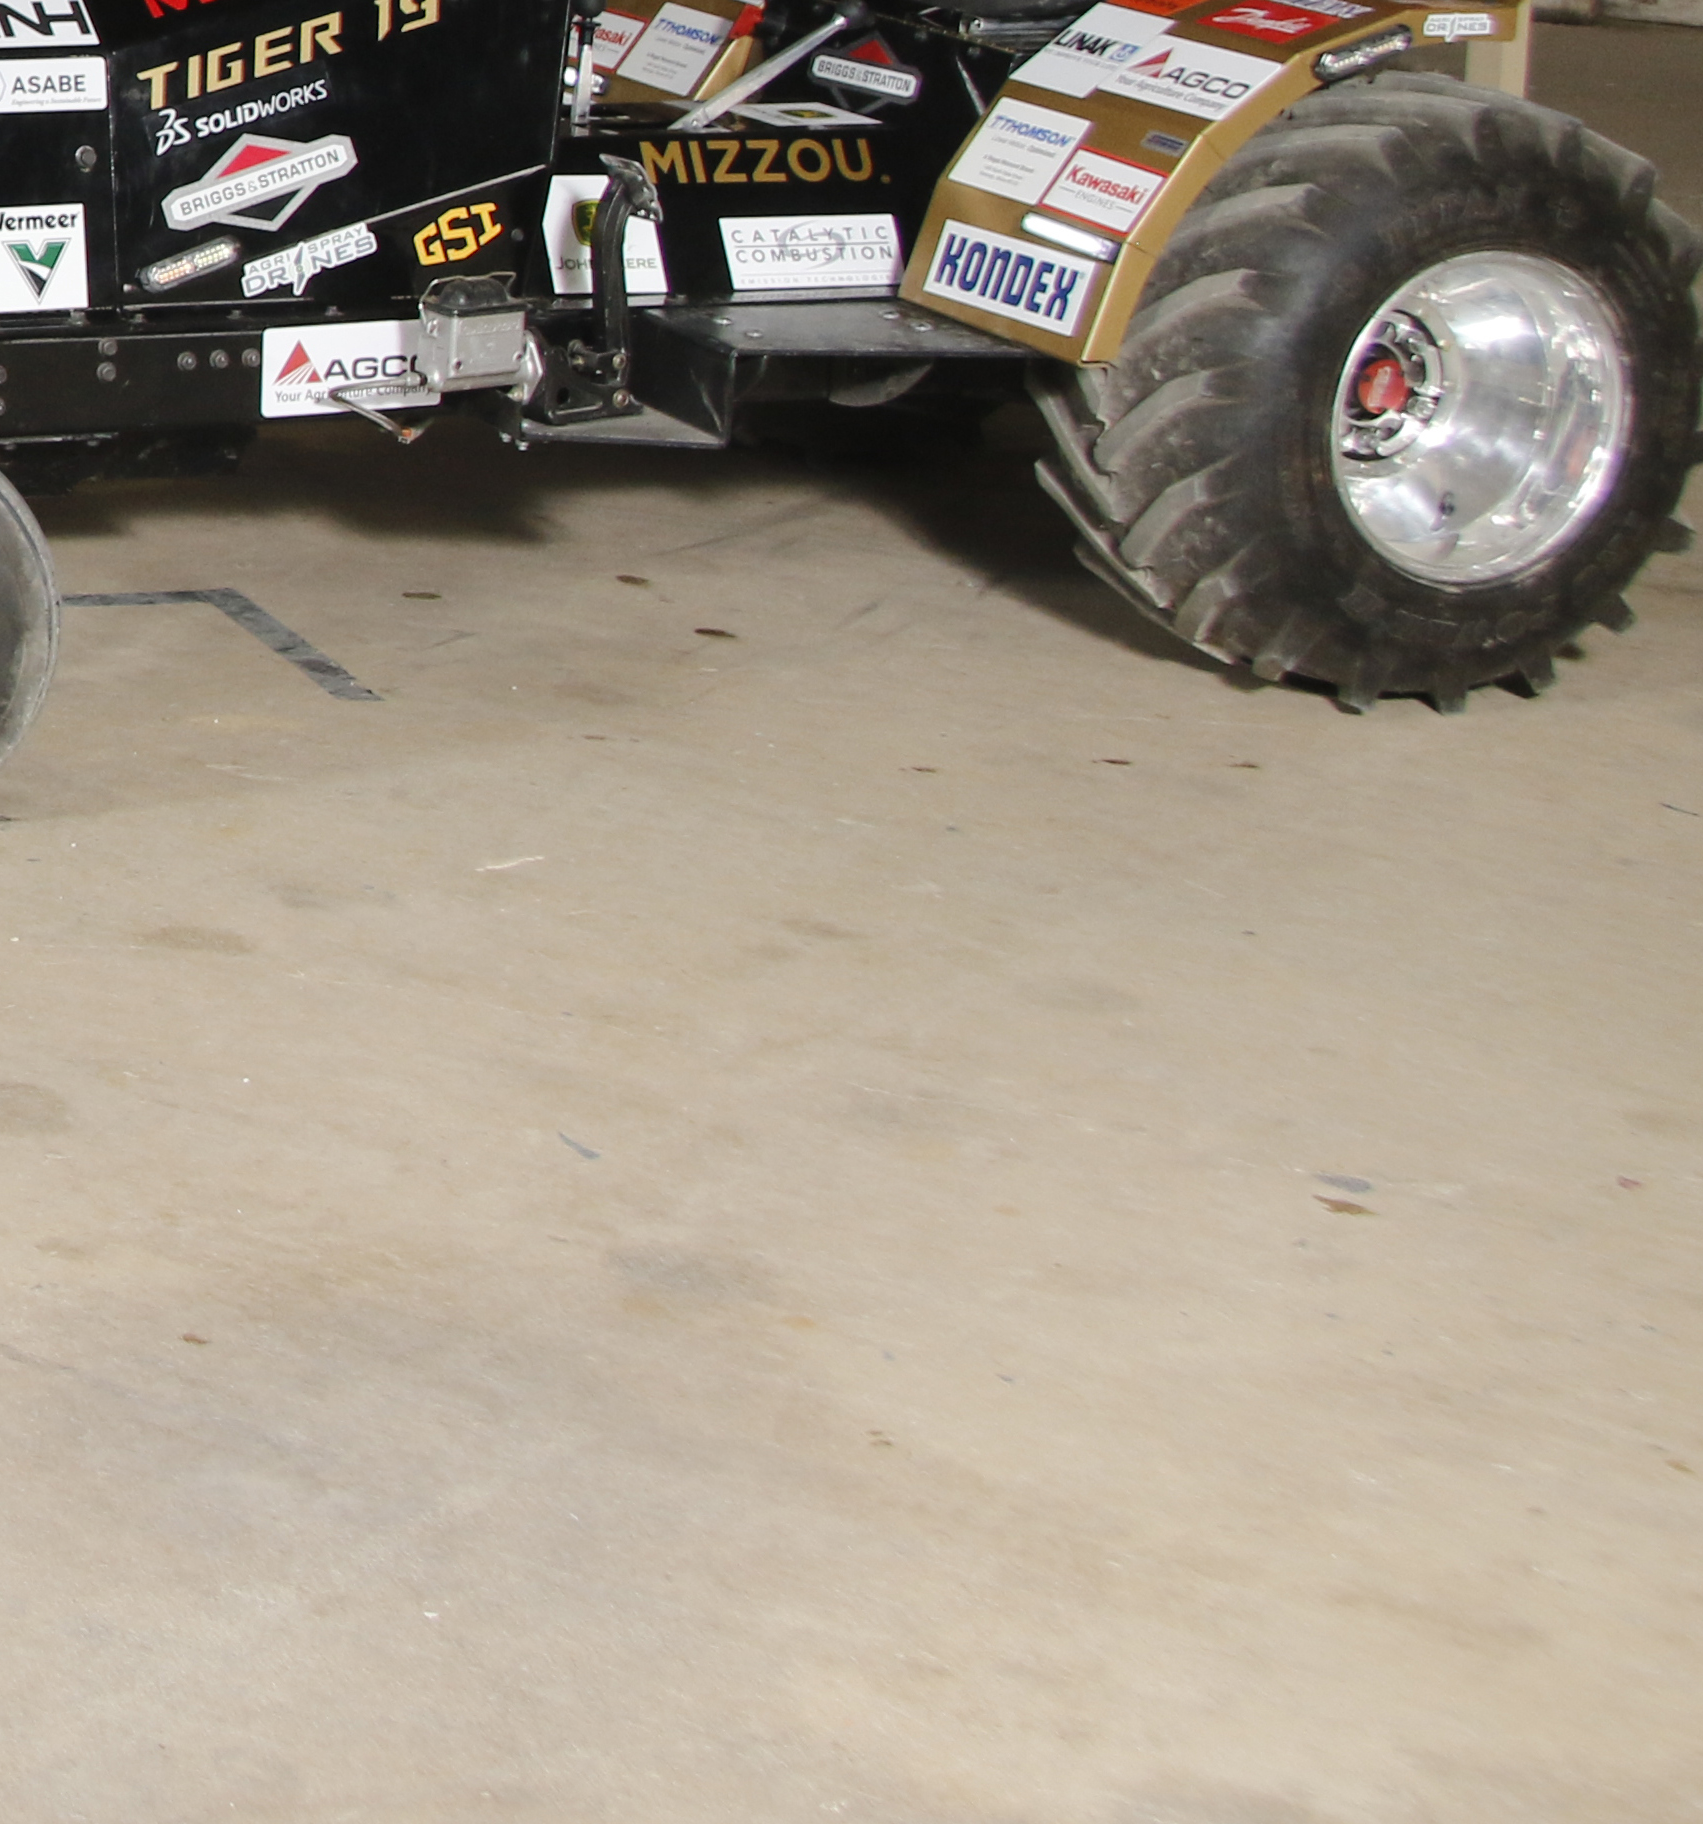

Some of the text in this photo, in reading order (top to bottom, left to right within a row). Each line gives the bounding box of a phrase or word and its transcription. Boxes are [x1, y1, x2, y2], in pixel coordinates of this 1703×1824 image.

[596, 27, 633, 46] asaki
[1054, 29, 1119, 57] LINAK
[136, 11, 345, 110] TIGER
[12, 75, 86, 95] ASABE
[1162, 67, 1251, 99] AGCO
[195, 78, 329, 138] SOLIDWORKS
[1065, 165, 1146, 204] Kawasaki
[1075, 190, 1118, 210] ENGINES
[413, 202, 503, 266] GSI
[731, 226, 889, 243] CATALYTIC
[248, 226, 364, 275] AGRI SPRAY
[557, 257, 657, 270] JOH ERE
[736, 247, 894, 263] COMBUSTION
[934, 234, 1080, 322] KONDEX
[324, 356, 417, 381] AGC
[275, 391, 301, 403] Your
